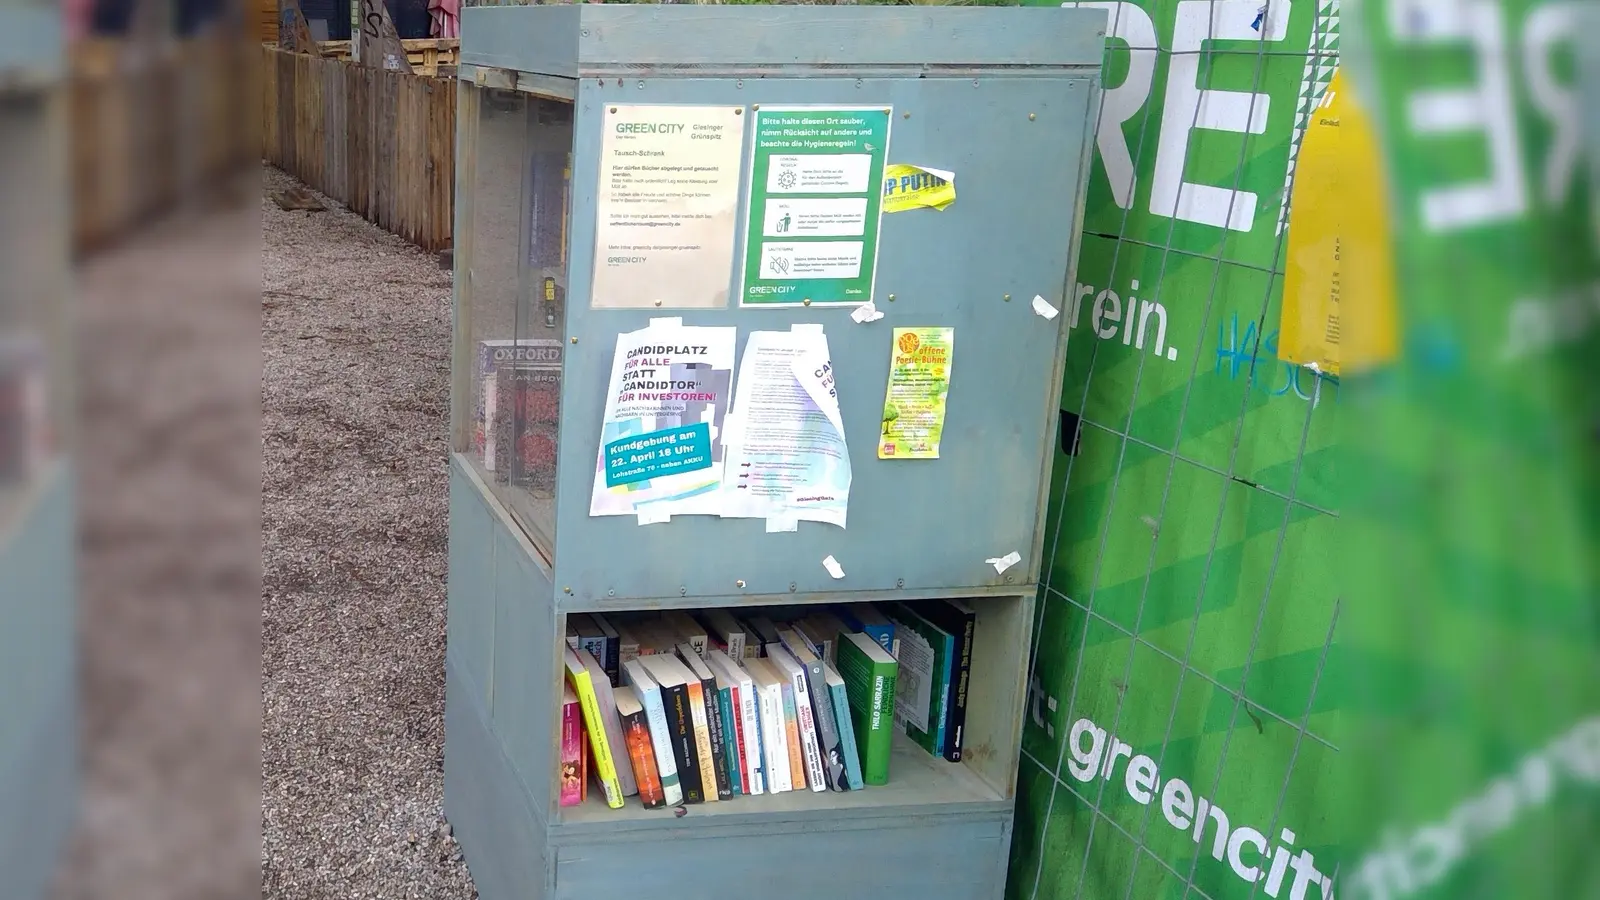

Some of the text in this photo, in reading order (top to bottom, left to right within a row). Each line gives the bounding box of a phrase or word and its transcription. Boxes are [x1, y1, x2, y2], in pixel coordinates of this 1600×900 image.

[840, 118, 866, 126] sauber,
[616, 123, 656, 133] GREEN
[659, 124, 684, 134] CITY
[760, 140, 790, 148] beachte
[804, 141, 857, 149] Hygieneregeln!
[750, 286, 778, 294] GREEN
[778, 286, 796, 294] CITY
[494, 348, 560, 360] OXFORD
[627, 346, 708, 359] CANDIDPLATZ
[919, 347, 946, 355] offene
[625, 358, 671, 371] FÜR ALLE
[896, 356, 947, 365] Poesie-Bühne
[622, 370, 656, 382] STATT
[620, 381, 702, 394] „CANDIDTOR“
[618, 392, 717, 404] FÜR INVESTOREN!
[610, 431, 697, 455] Kundgebung am
[611, 458, 627, 468] 22.
[630, 451, 655, 465] April
[675, 445, 695, 455] Uhr
[872, 676, 884, 730] THILO SARRAZIN
